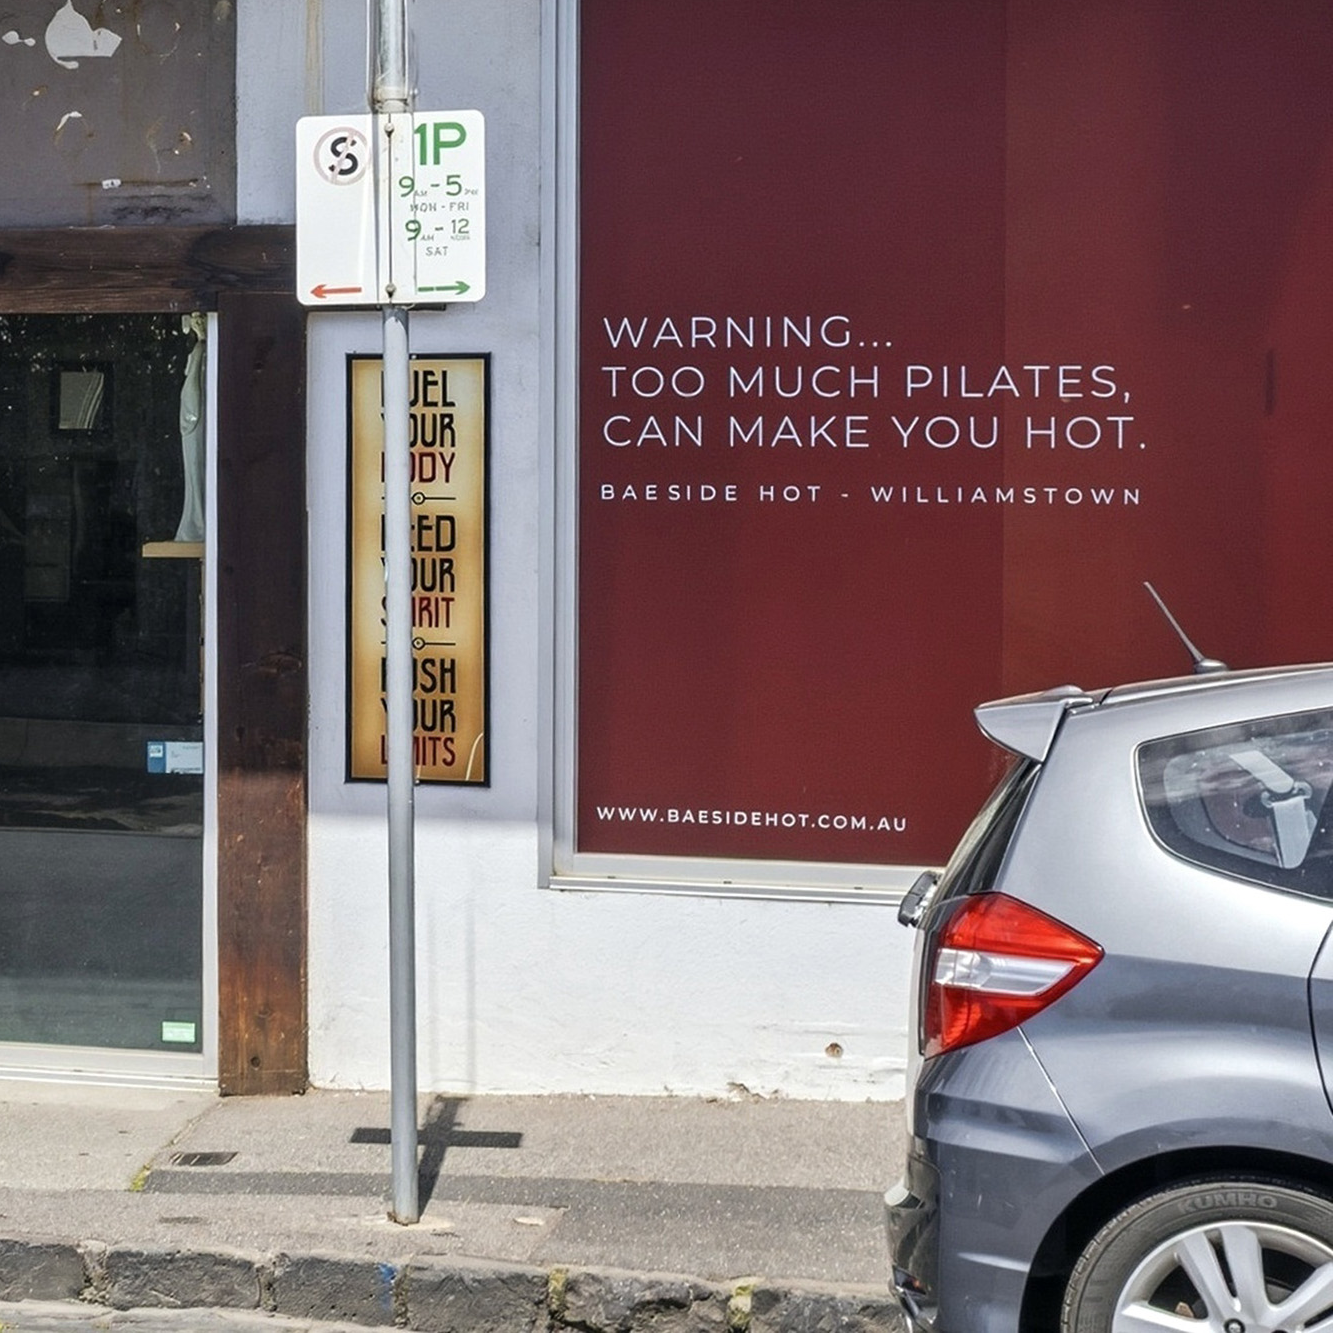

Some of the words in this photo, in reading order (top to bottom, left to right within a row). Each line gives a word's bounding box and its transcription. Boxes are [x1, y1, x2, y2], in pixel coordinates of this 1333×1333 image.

[414, 122, 467, 166] 1P
[450, 202, 469, 211] FRI
[451, 218, 469, 234] 12
[425, 246, 448, 257] SAT
[603, 315, 892, 348] WARNING...
[601, 366, 705, 398] TOO
[729, 365, 878, 398] MUCH
[906, 365, 1131, 404] PILATES,
[603, 415, 702, 447] CAN
[729, 415, 870, 448] MAKE
[891, 416, 998, 449] YOU
[1026, 416, 1146, 450] HOT.
[601, 484, 737, 502] BAESIDE
[759, 485, 821, 502] HOT
[870, 486, 1140, 505] WILLIAMSTOWN
[596, 806, 907, 832] WWW.BAESIDEHOT.COM.AU
[1177, 1191, 1278, 1215] KUMHO
